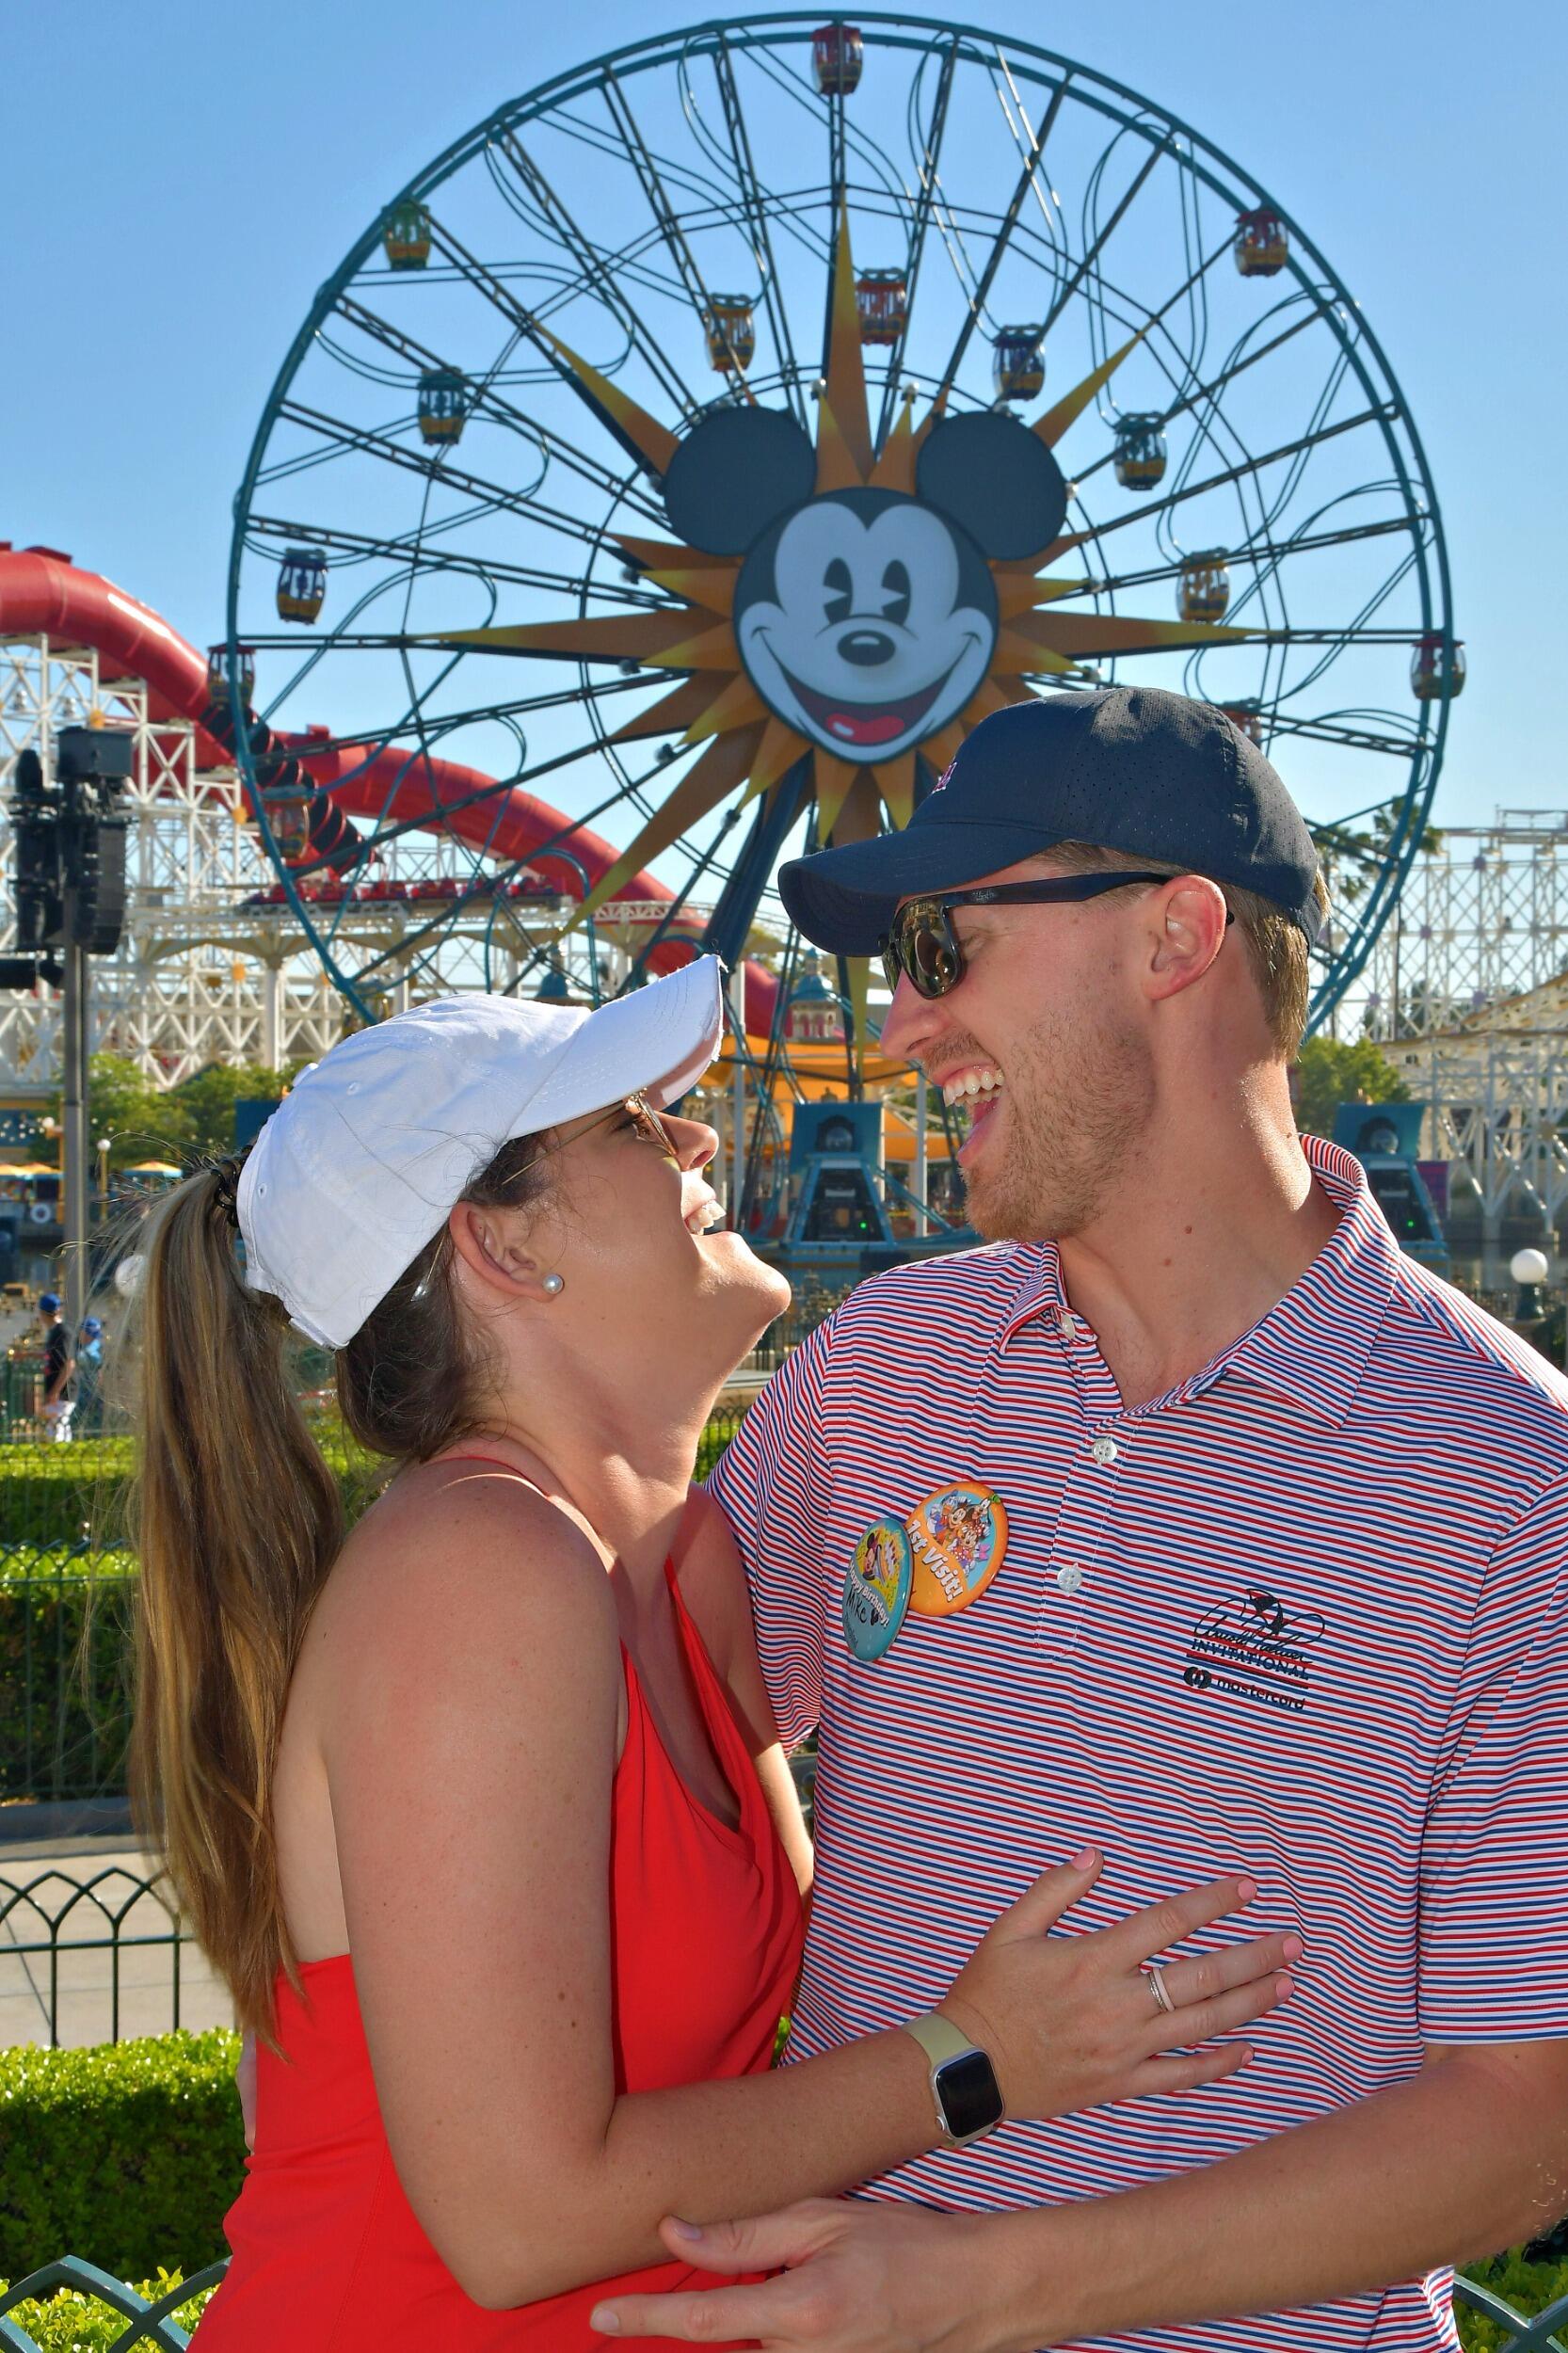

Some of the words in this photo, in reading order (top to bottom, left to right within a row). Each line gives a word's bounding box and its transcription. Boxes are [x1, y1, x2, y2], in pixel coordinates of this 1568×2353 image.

[908, 1519, 928, 1553] 1st
[921, 1547, 963, 1602] Visit!
[849, 1561, 864, 1593] Happy
[862, 1586, 889, 1629] Birthday!
[1191, 1638, 1309, 1681] INVITATIONAL
[1217, 1678, 1305, 1710] mastercard
